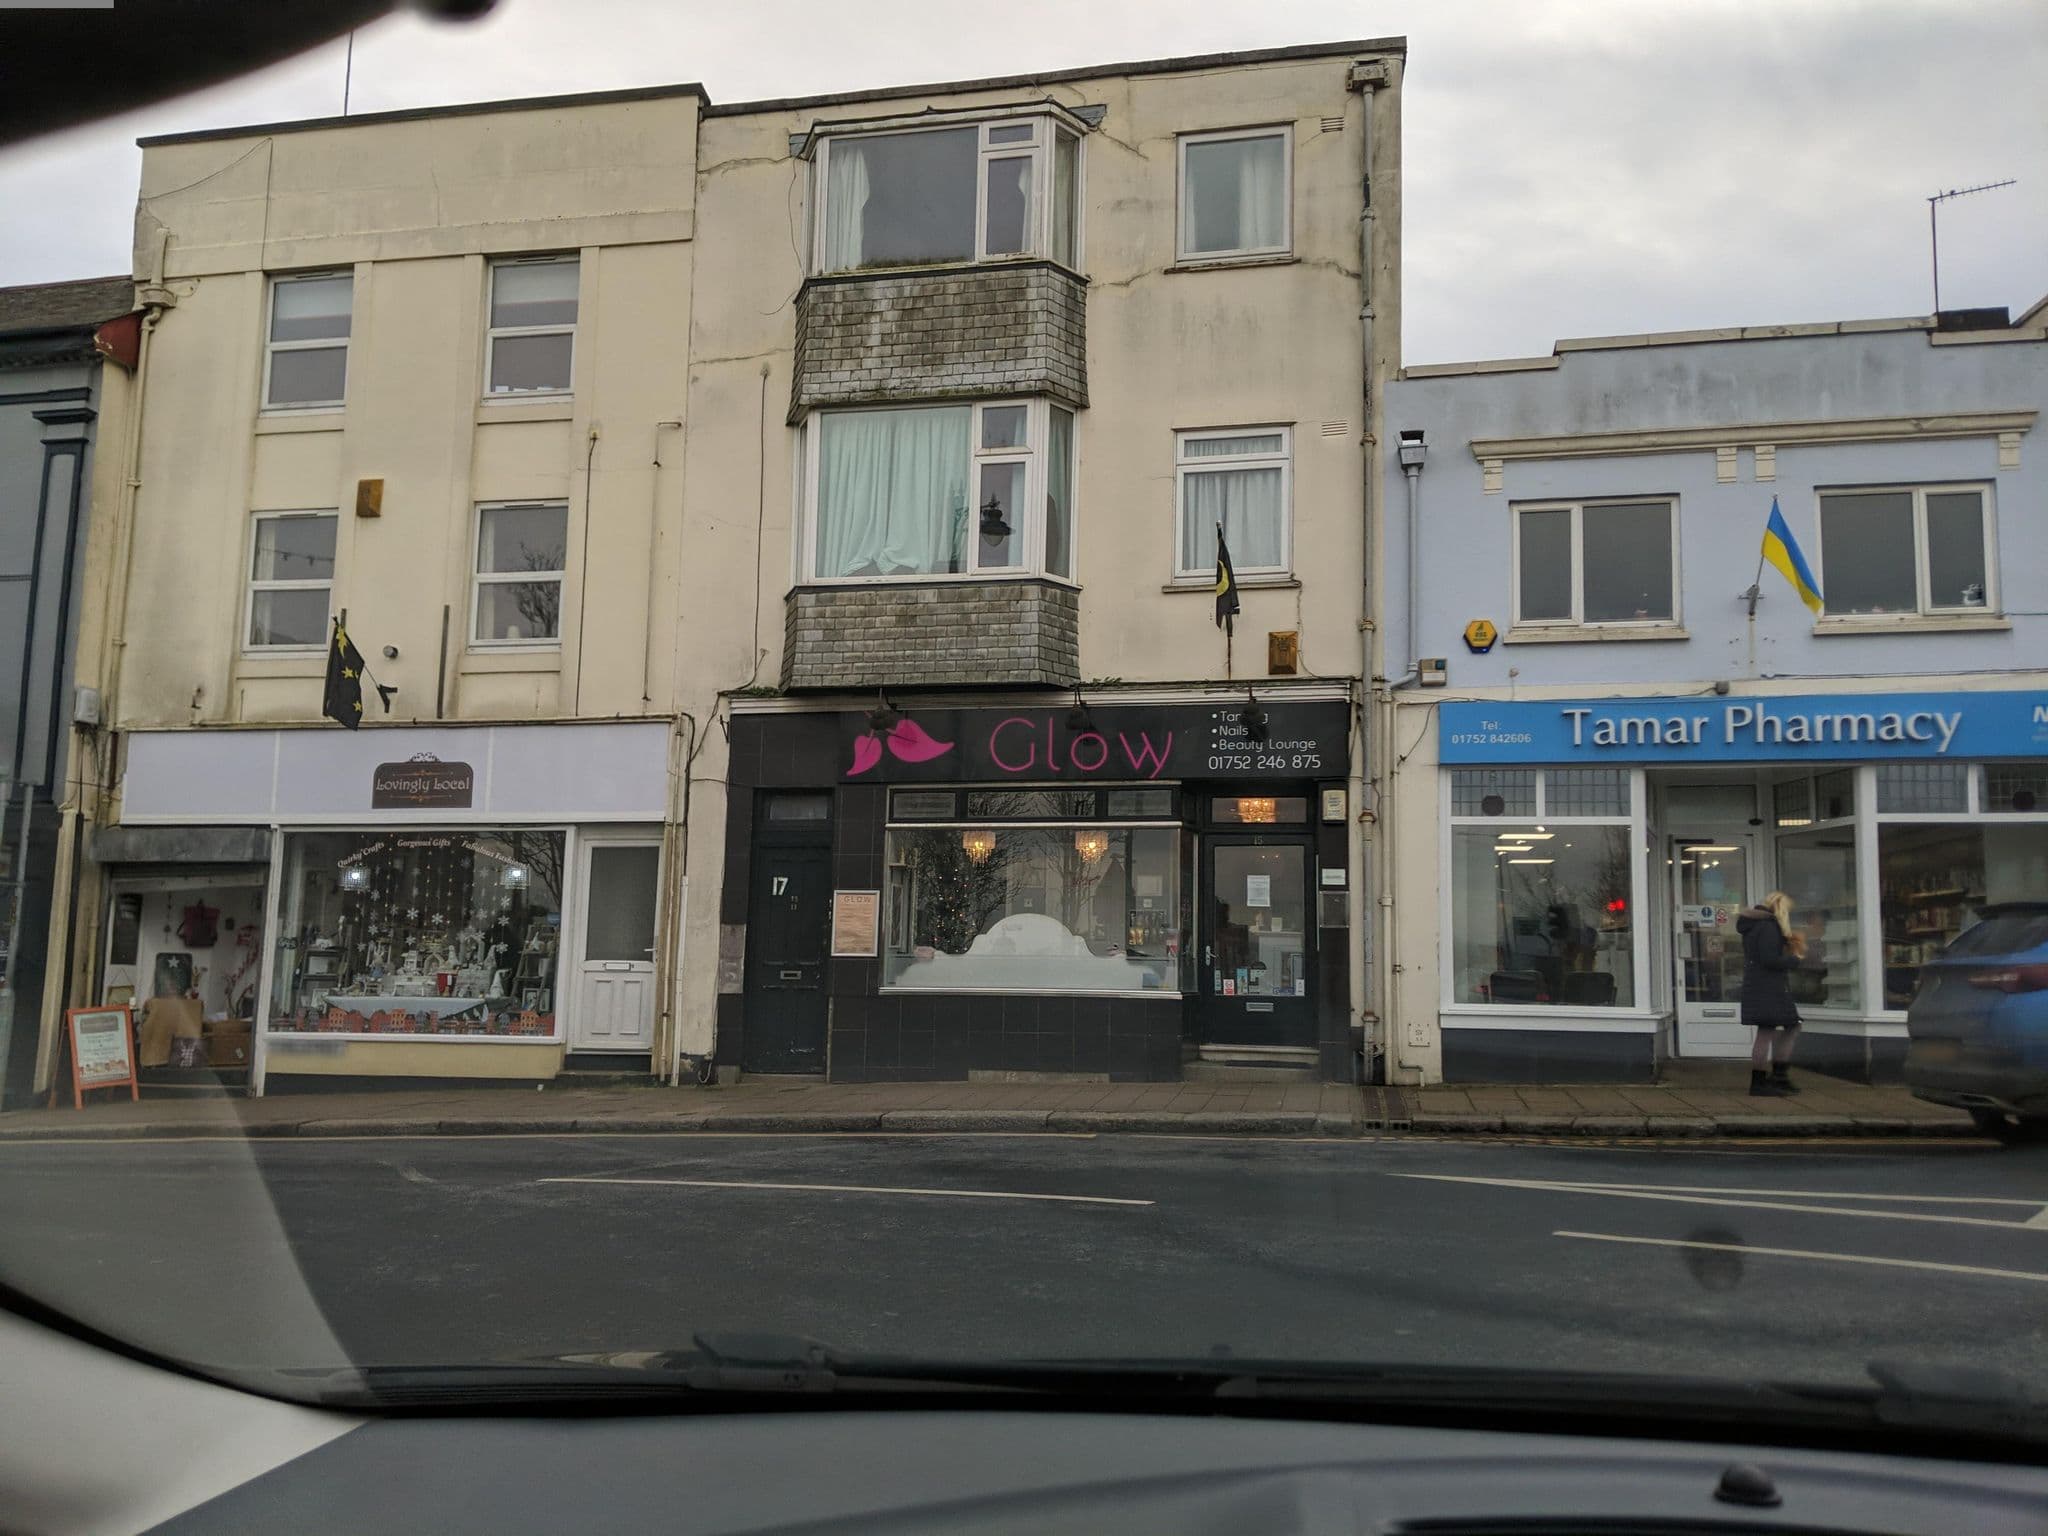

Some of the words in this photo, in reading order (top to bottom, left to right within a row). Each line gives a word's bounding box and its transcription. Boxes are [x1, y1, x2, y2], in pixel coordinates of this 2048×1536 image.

[1219, 725, 1249, 737] Nails
[1481, 720, 1501, 731] Tel:
[1562, 708, 1709, 747] Tamar
[1724, 702, 1962, 753] Pharmacy
[1219, 739, 1263, 752] Beauty
[1269, 738, 1317, 752] Lounge
[1452, 733, 1487, 745] 01752
[1490, 732, 1532, 744] 842606
[990, 717, 1173, 778] Glow
[1208, 755, 1252, 770] 01752
[1257, 755, 1286, 769] 246
[1292, 754, 1321, 769] 875
[376, 777, 430, 793] Lovingly
[433, 777, 470, 790] Local
[772, 876, 789, 896] 17
[844, 895, 871, 903] GLOW
